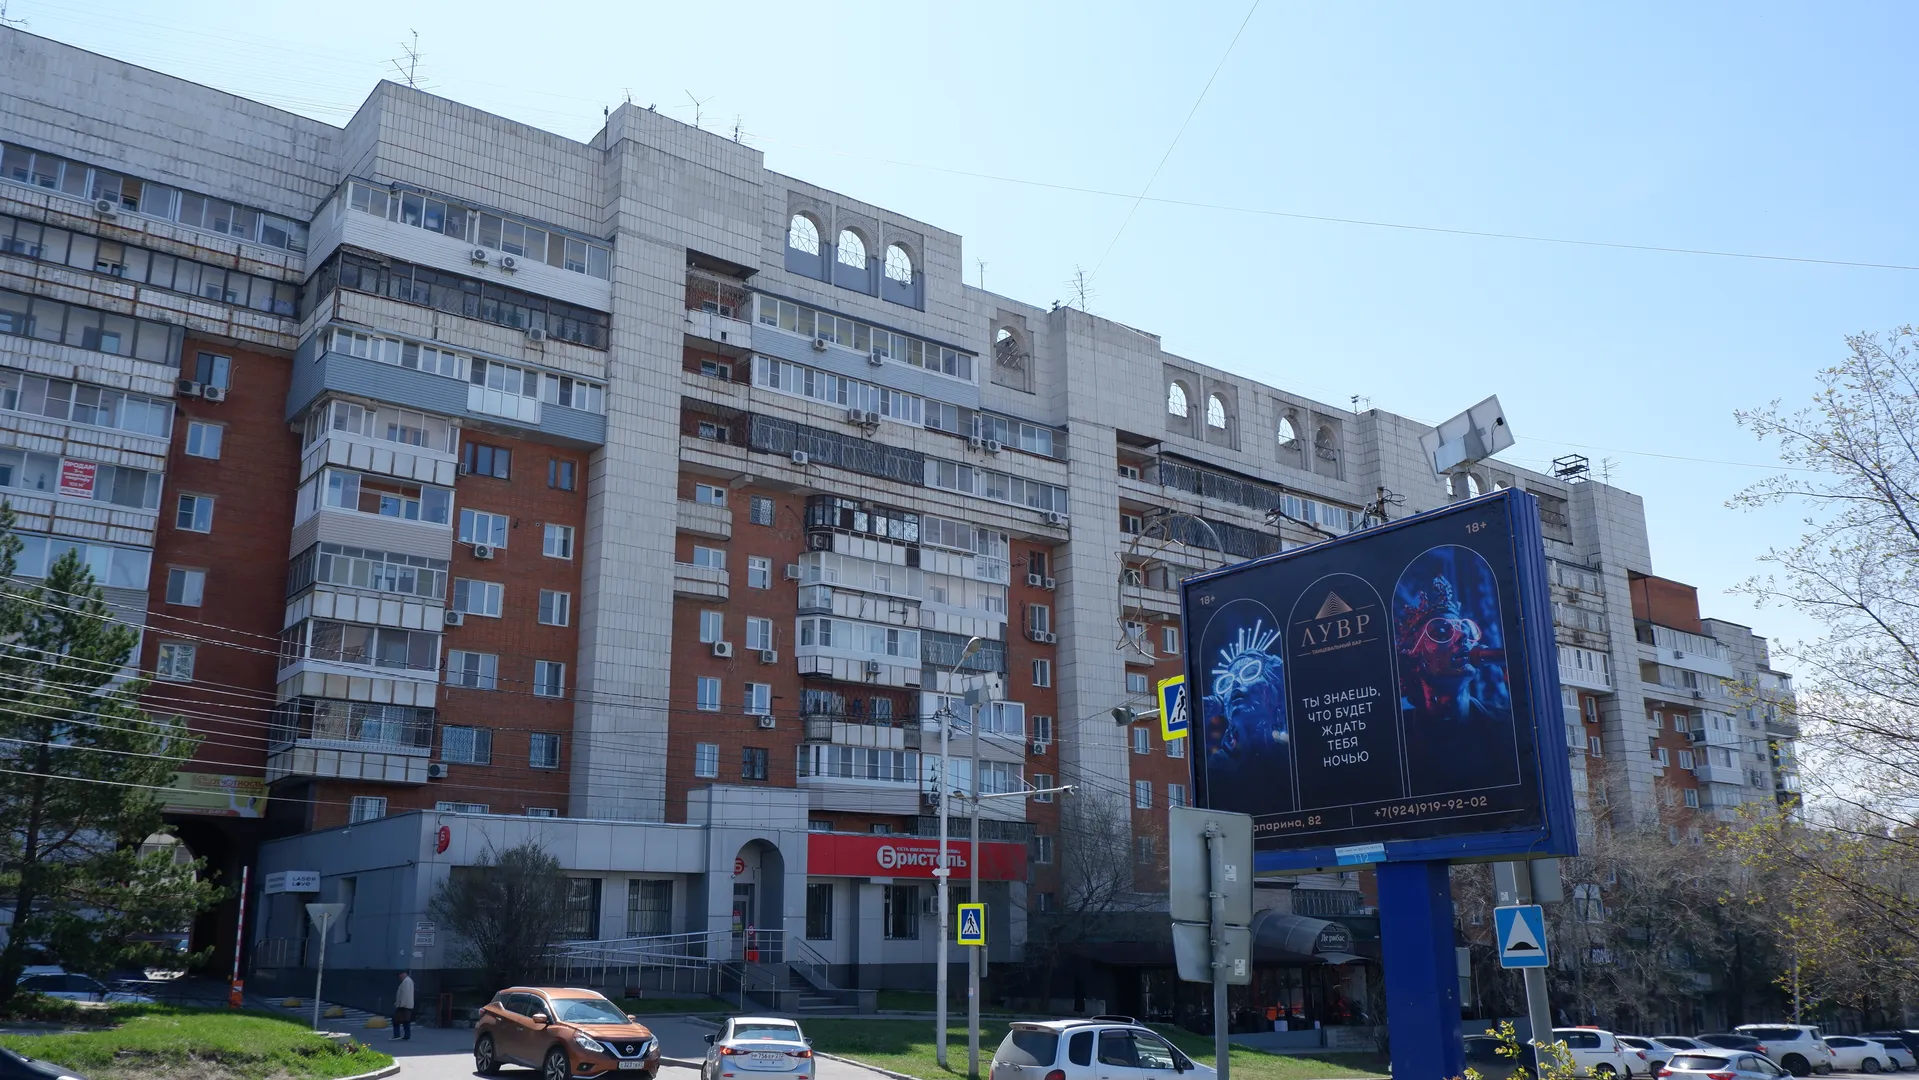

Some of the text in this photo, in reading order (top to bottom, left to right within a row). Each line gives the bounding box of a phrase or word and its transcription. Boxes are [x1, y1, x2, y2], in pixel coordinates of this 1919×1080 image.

[1466, 521, 1487, 534] 18+
[1200, 595, 1215, 605] 18+
[1300, 615, 1371, 647] ЛУВР
[1303, 687, 1381, 709] ТЫ ЗНАЕШЬ,
[1308, 703, 1373, 723] ЧТО БУДЕТ
[1322, 720, 1366, 736] ЖДАТЬ
[1328, 736, 1357, 752] ТЕБЯ
[1323, 751, 1369, 767] НОЧЬЮ
[1374, 797, 1487, 818] +7(924)919-92-02
[1253, 815, 1322, 831] апарина, 82
